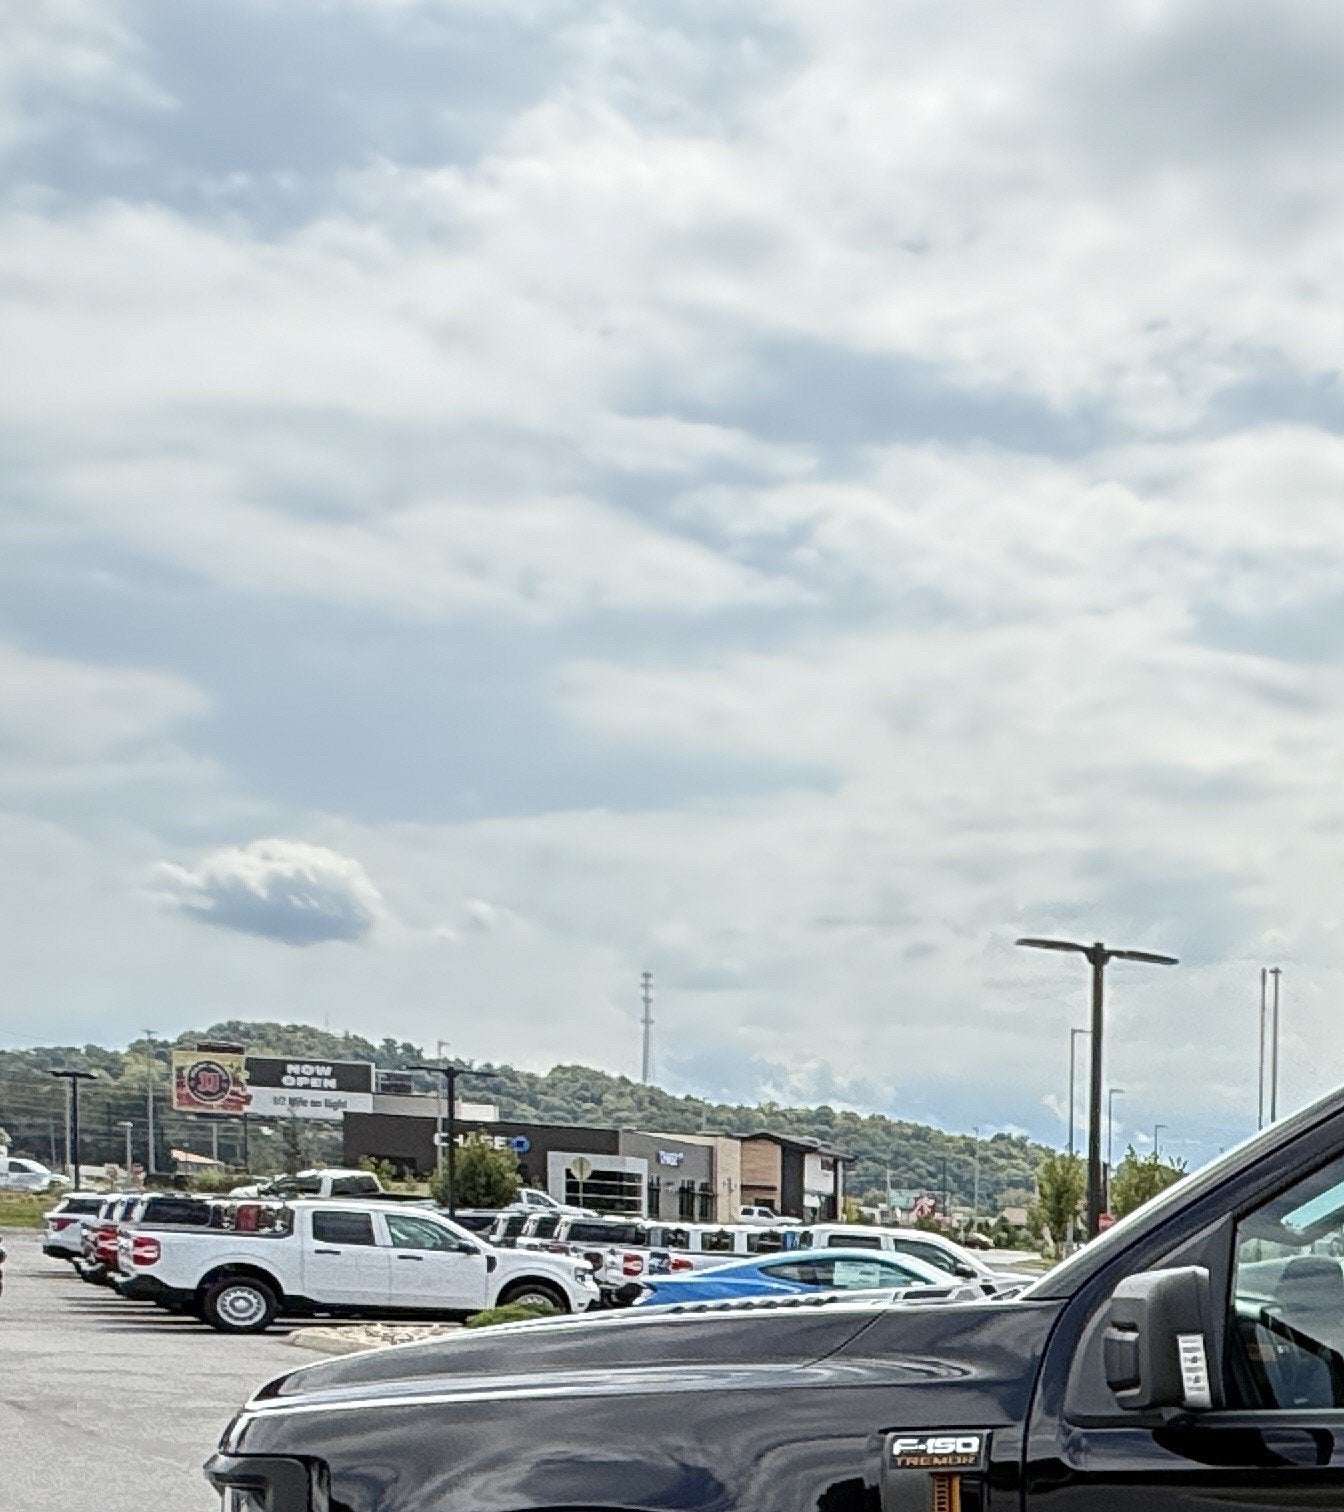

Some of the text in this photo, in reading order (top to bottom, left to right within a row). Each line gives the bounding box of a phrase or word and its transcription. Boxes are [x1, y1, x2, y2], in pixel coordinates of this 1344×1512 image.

[286, 1063, 333, 1076] NOW
[281, 1075, 338, 1089] OPEN
[892, 1436, 980, 1455] F-150
[895, 1455, 976, 1467] TREMOR
